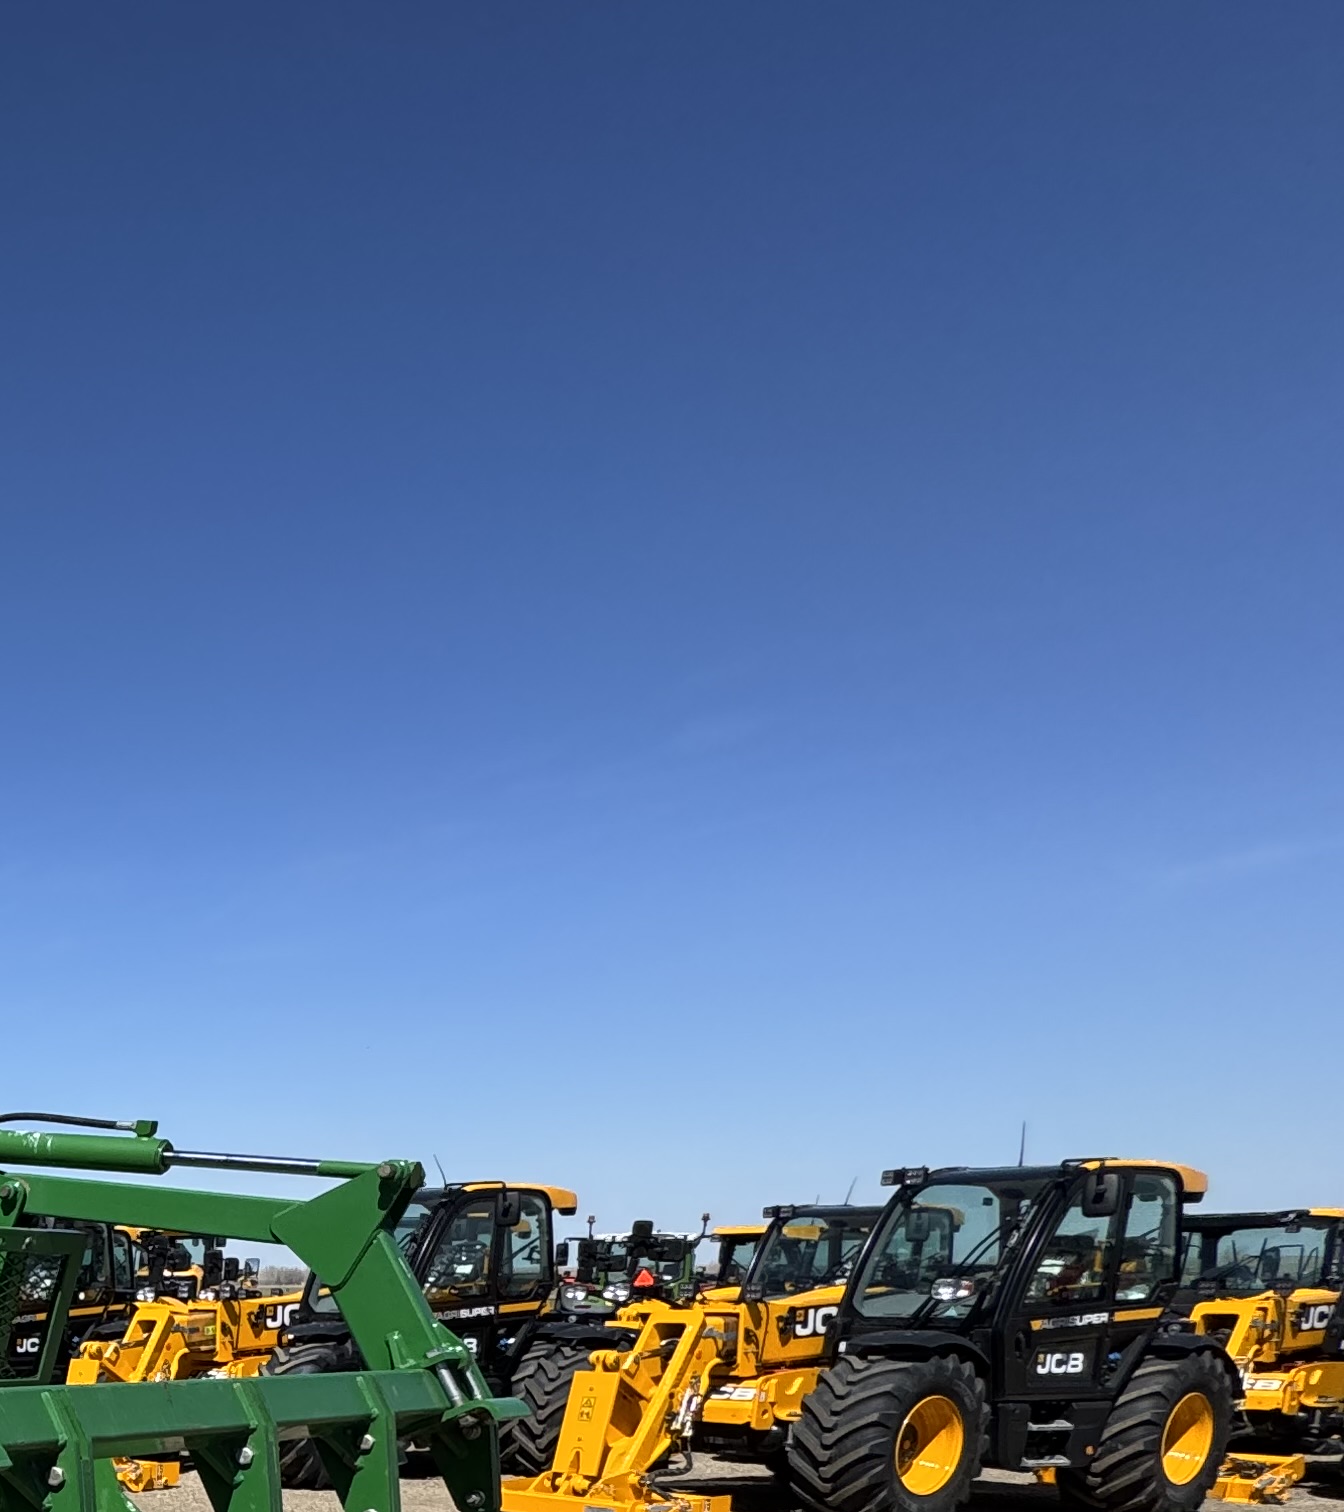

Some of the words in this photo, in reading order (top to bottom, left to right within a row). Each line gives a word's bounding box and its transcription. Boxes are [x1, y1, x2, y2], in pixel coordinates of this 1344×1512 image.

[266, 1304, 300, 1328] JC
[795, 1306, 838, 1336] JC
[1301, 1305, 1335, 1330] JC
[16, 1337, 40, 1353] JC
[1036, 1352, 1084, 1374] JCB
[710, 1386, 757, 1401] CB
